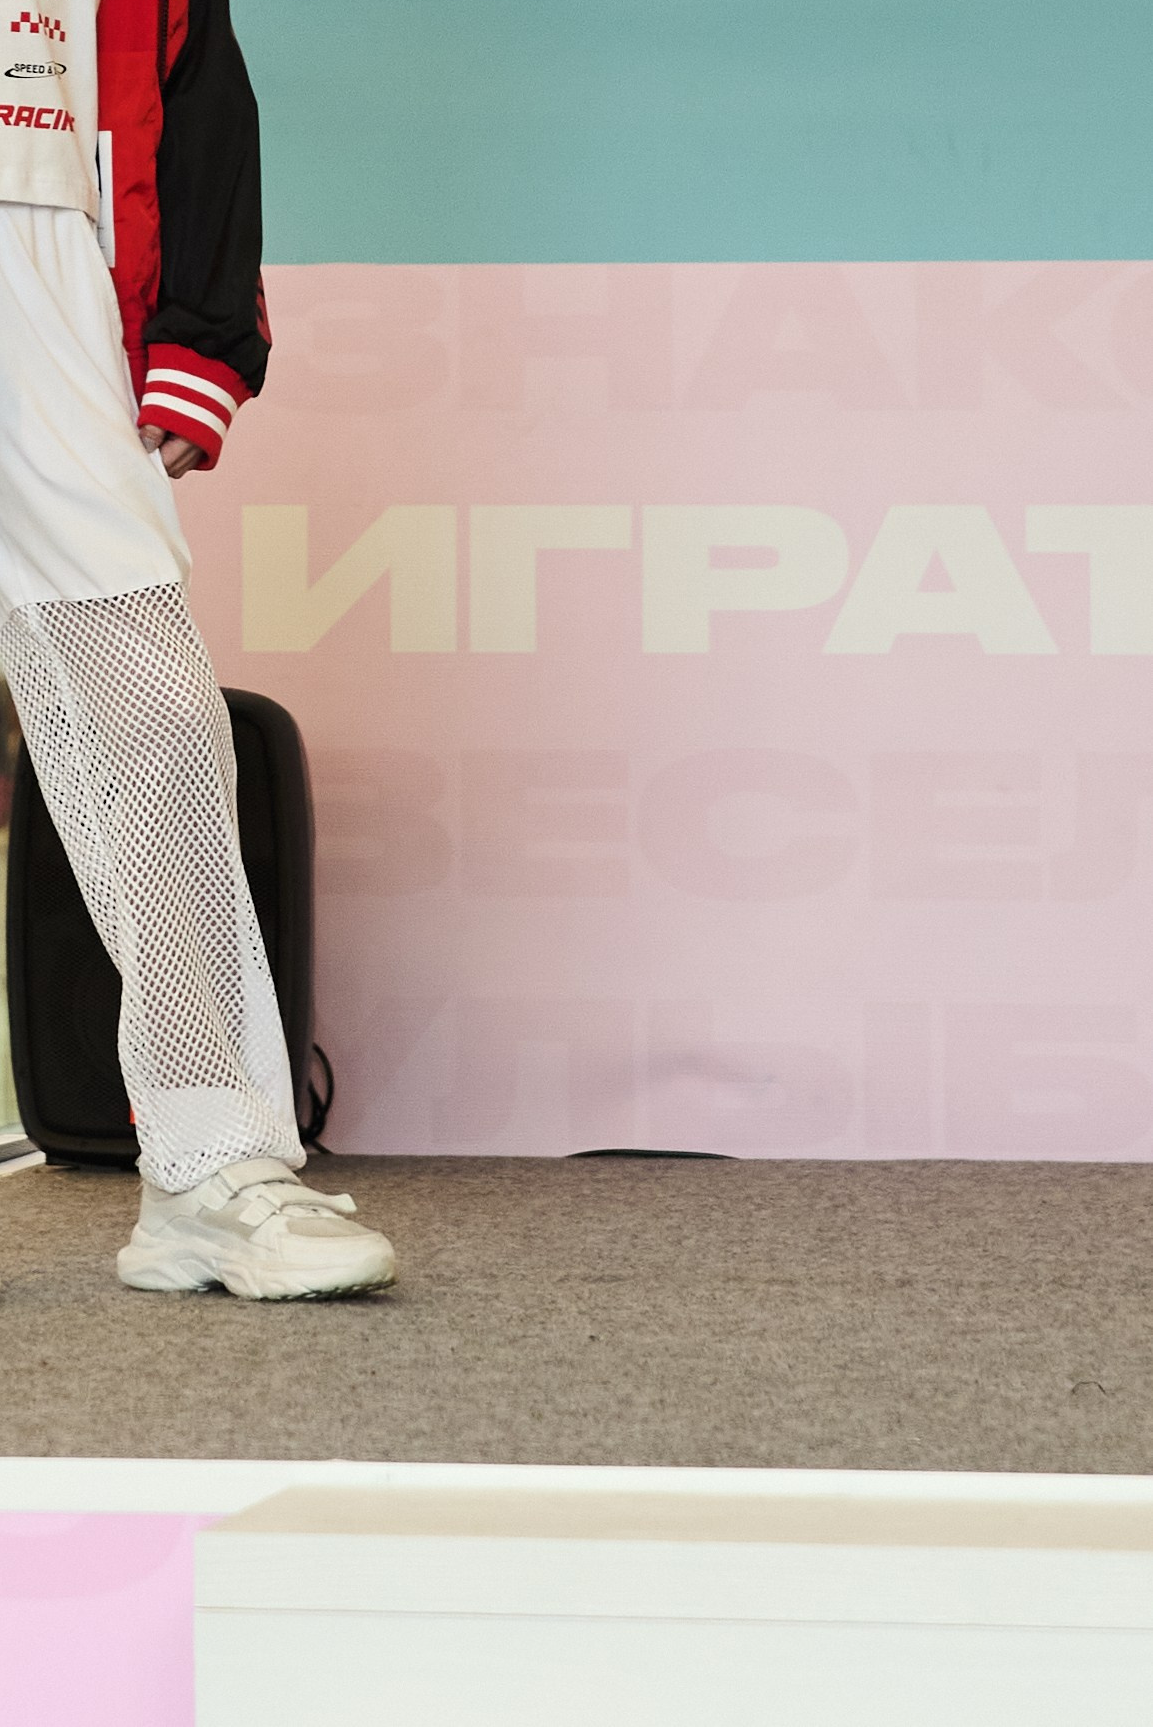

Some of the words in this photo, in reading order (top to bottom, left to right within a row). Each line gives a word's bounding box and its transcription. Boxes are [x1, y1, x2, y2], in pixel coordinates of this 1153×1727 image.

[14, 63, 45, 74] SPEED
[269, 264, 1153, 411] ЗНАК
[242, 504, 1153, 655] ИГРАТ
